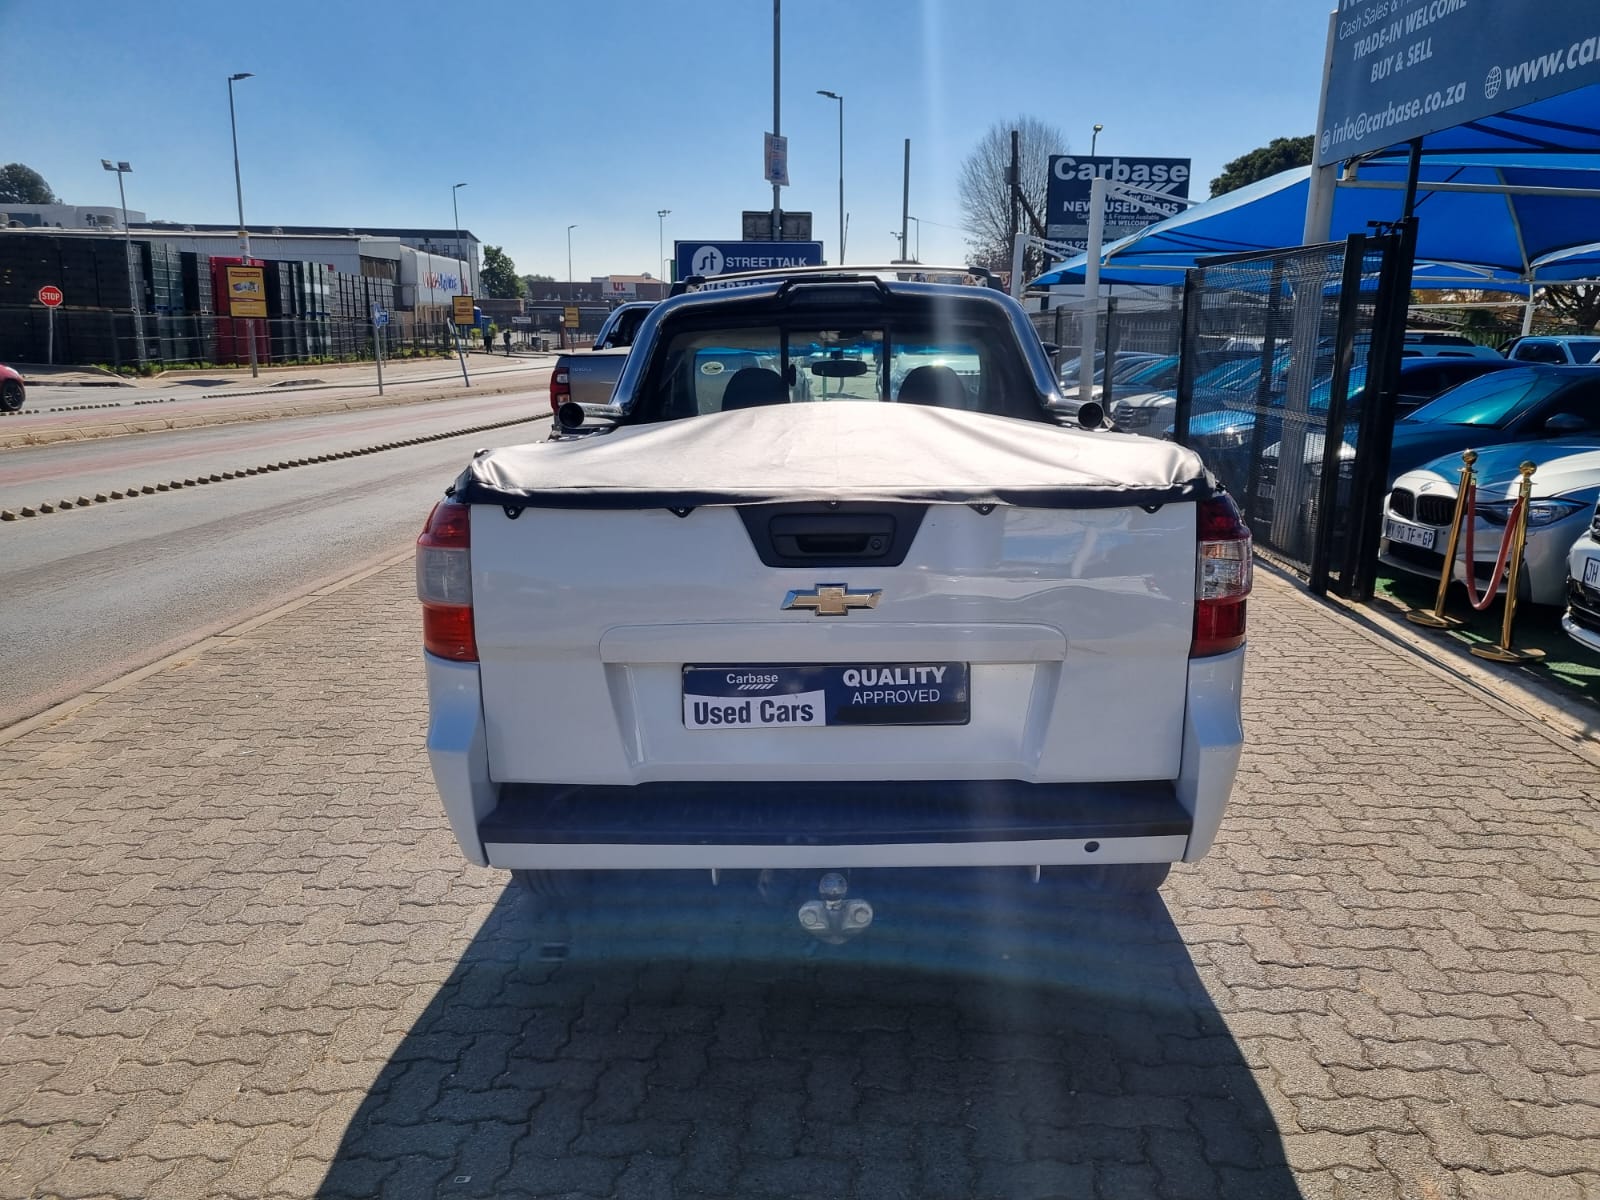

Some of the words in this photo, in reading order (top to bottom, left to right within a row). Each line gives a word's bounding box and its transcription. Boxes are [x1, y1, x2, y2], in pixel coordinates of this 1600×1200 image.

[1339, 14, 1362, 41] Cash
[1362, 1, 1389, 28] Sales
[1353, 18, 1404, 61] TRADE-IN
[1405, 0, 1467, 35] WELCOME
[1370, 54, 1394, 83] BUY
[1395, 51, 1404, 73] &
[1406, 37, 1434, 67] SELL
[1332, 80, 1467, 144] info@carbase.co.za
[1054, 157, 1189, 182] Carbase
[1106, 202, 1140, 213] USED
[726, 257, 773, 268] STREET
[775, 257, 807, 268] TALK
[41, 292, 60, 301] STOP
[612, 281, 626, 291] UL
[1407, 527, 1417, 542] TF
[1422, 531, 1434, 547] GP
[1585, 562, 1600, 584] JH
[725, 673, 779, 684] Carbase
[843, 666, 946, 687] QUALITY
[852, 689, 941, 705] APPROVED
[693, 701, 752, 725] Used
[759, 700, 814, 723] Cars
